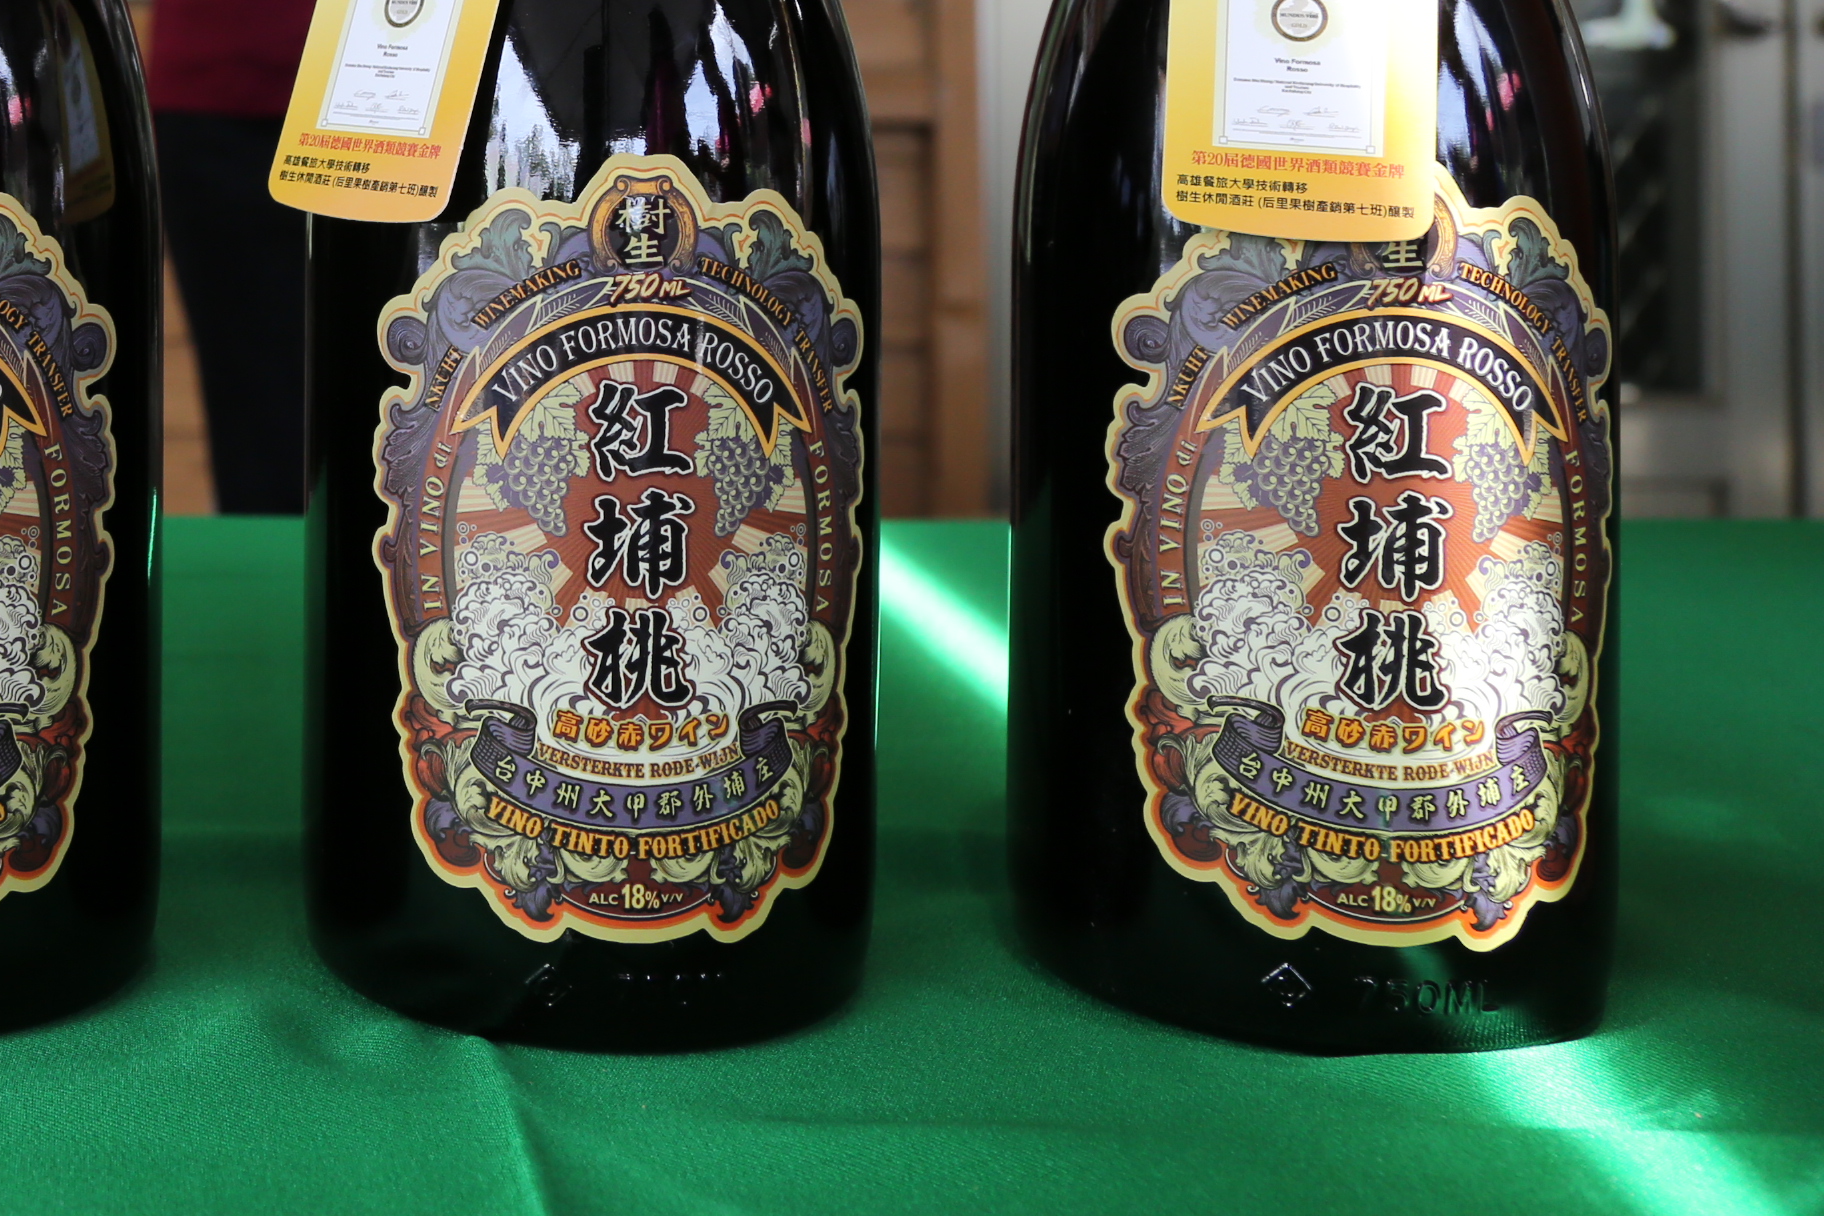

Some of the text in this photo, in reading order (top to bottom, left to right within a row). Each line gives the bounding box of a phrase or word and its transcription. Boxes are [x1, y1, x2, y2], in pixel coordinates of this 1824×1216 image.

[616, 197, 671, 265] 樹生
[606, 273, 660, 305] 750
[1364, 278, 1416, 308] 750
[472, 259, 581, 331] WINEMAKING
[699, 257, 797, 329] TECHNOLOGY
[796, 327, 832, 413] TRANSFER
[492, 318, 774, 405] VINO FORMOSA ROSSO
[1220, 263, 1339, 330] WINEMAKING
[1459, 262, 1554, 336] TECHNOLOGY
[1551, 336, 1588, 424] TRANSFER
[1242, 321, 1533, 412] VINO FORMOSA ROSSO
[27, 330, 74, 418] TRANSFER
[420, 476, 444, 556] VINO
[808, 439, 833, 613] FORMOSA
[1159, 473, 1188, 552] VINO
[1564, 449, 1588, 625] FORMOSA
[538, 742, 645, 780] VERSTERKTE
[552, 710, 730, 750] 高砂赤ワイン
[1285, 741, 1399, 781] VERSTERKTE
[1301, 710, 1484, 752] 高砂赤ワイン
[493, 755, 774, 819] 台中州大甲郡外埔庄
[1236, 753, 1531, 820] 台中州大甲郡外埔庄
[485, 796, 780, 860] VINO TINTO FORTIFICADO
[1230, 792, 1535, 863] VINO TINTO FORTIFICADO
[589, 892, 618, 905] ALC
[621, 884, 660, 909] 18%
[1337, 893, 1368, 907] ALC
[1370, 887, 1412, 913] 18%
